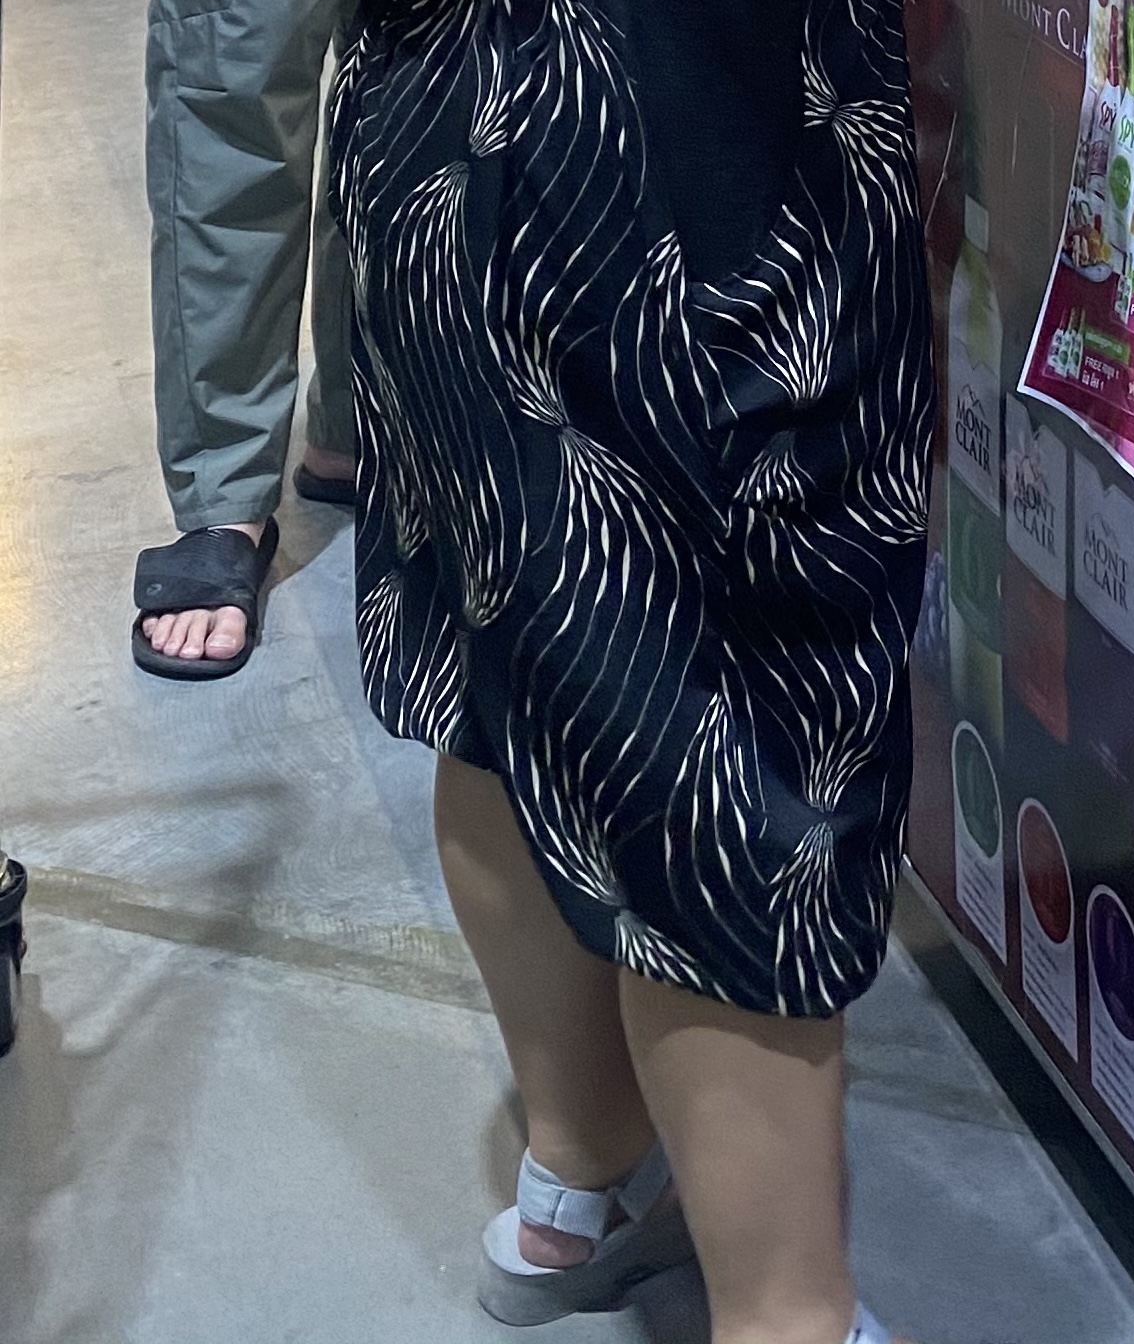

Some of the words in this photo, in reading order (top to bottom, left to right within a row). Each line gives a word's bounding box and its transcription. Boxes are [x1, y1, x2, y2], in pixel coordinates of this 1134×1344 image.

[955, 421, 991, 476] CLAIR
[956, 393, 991, 450] MONT
[1013, 495, 1057, 558] CLAIR
[1084, 520, 1128, 583] MONT
[1083, 550, 1129, 612] CLAIR
